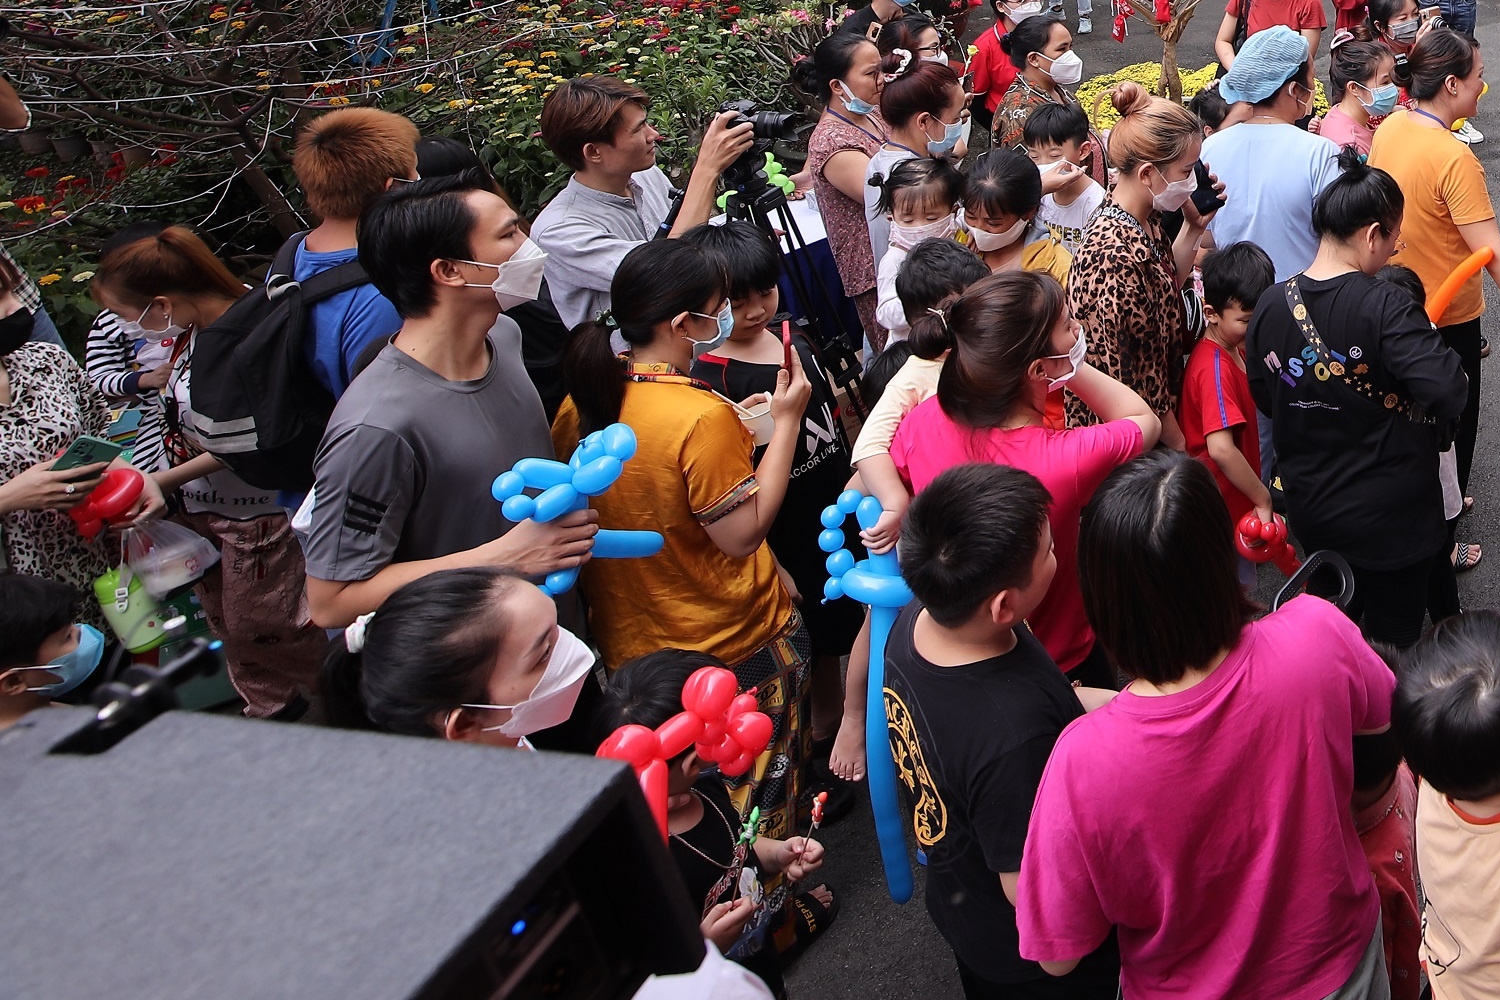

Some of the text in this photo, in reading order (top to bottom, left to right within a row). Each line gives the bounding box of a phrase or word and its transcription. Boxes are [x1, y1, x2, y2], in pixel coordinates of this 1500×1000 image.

[181, 488, 271, 506] with me
[800, 908, 817, 933] STEP
